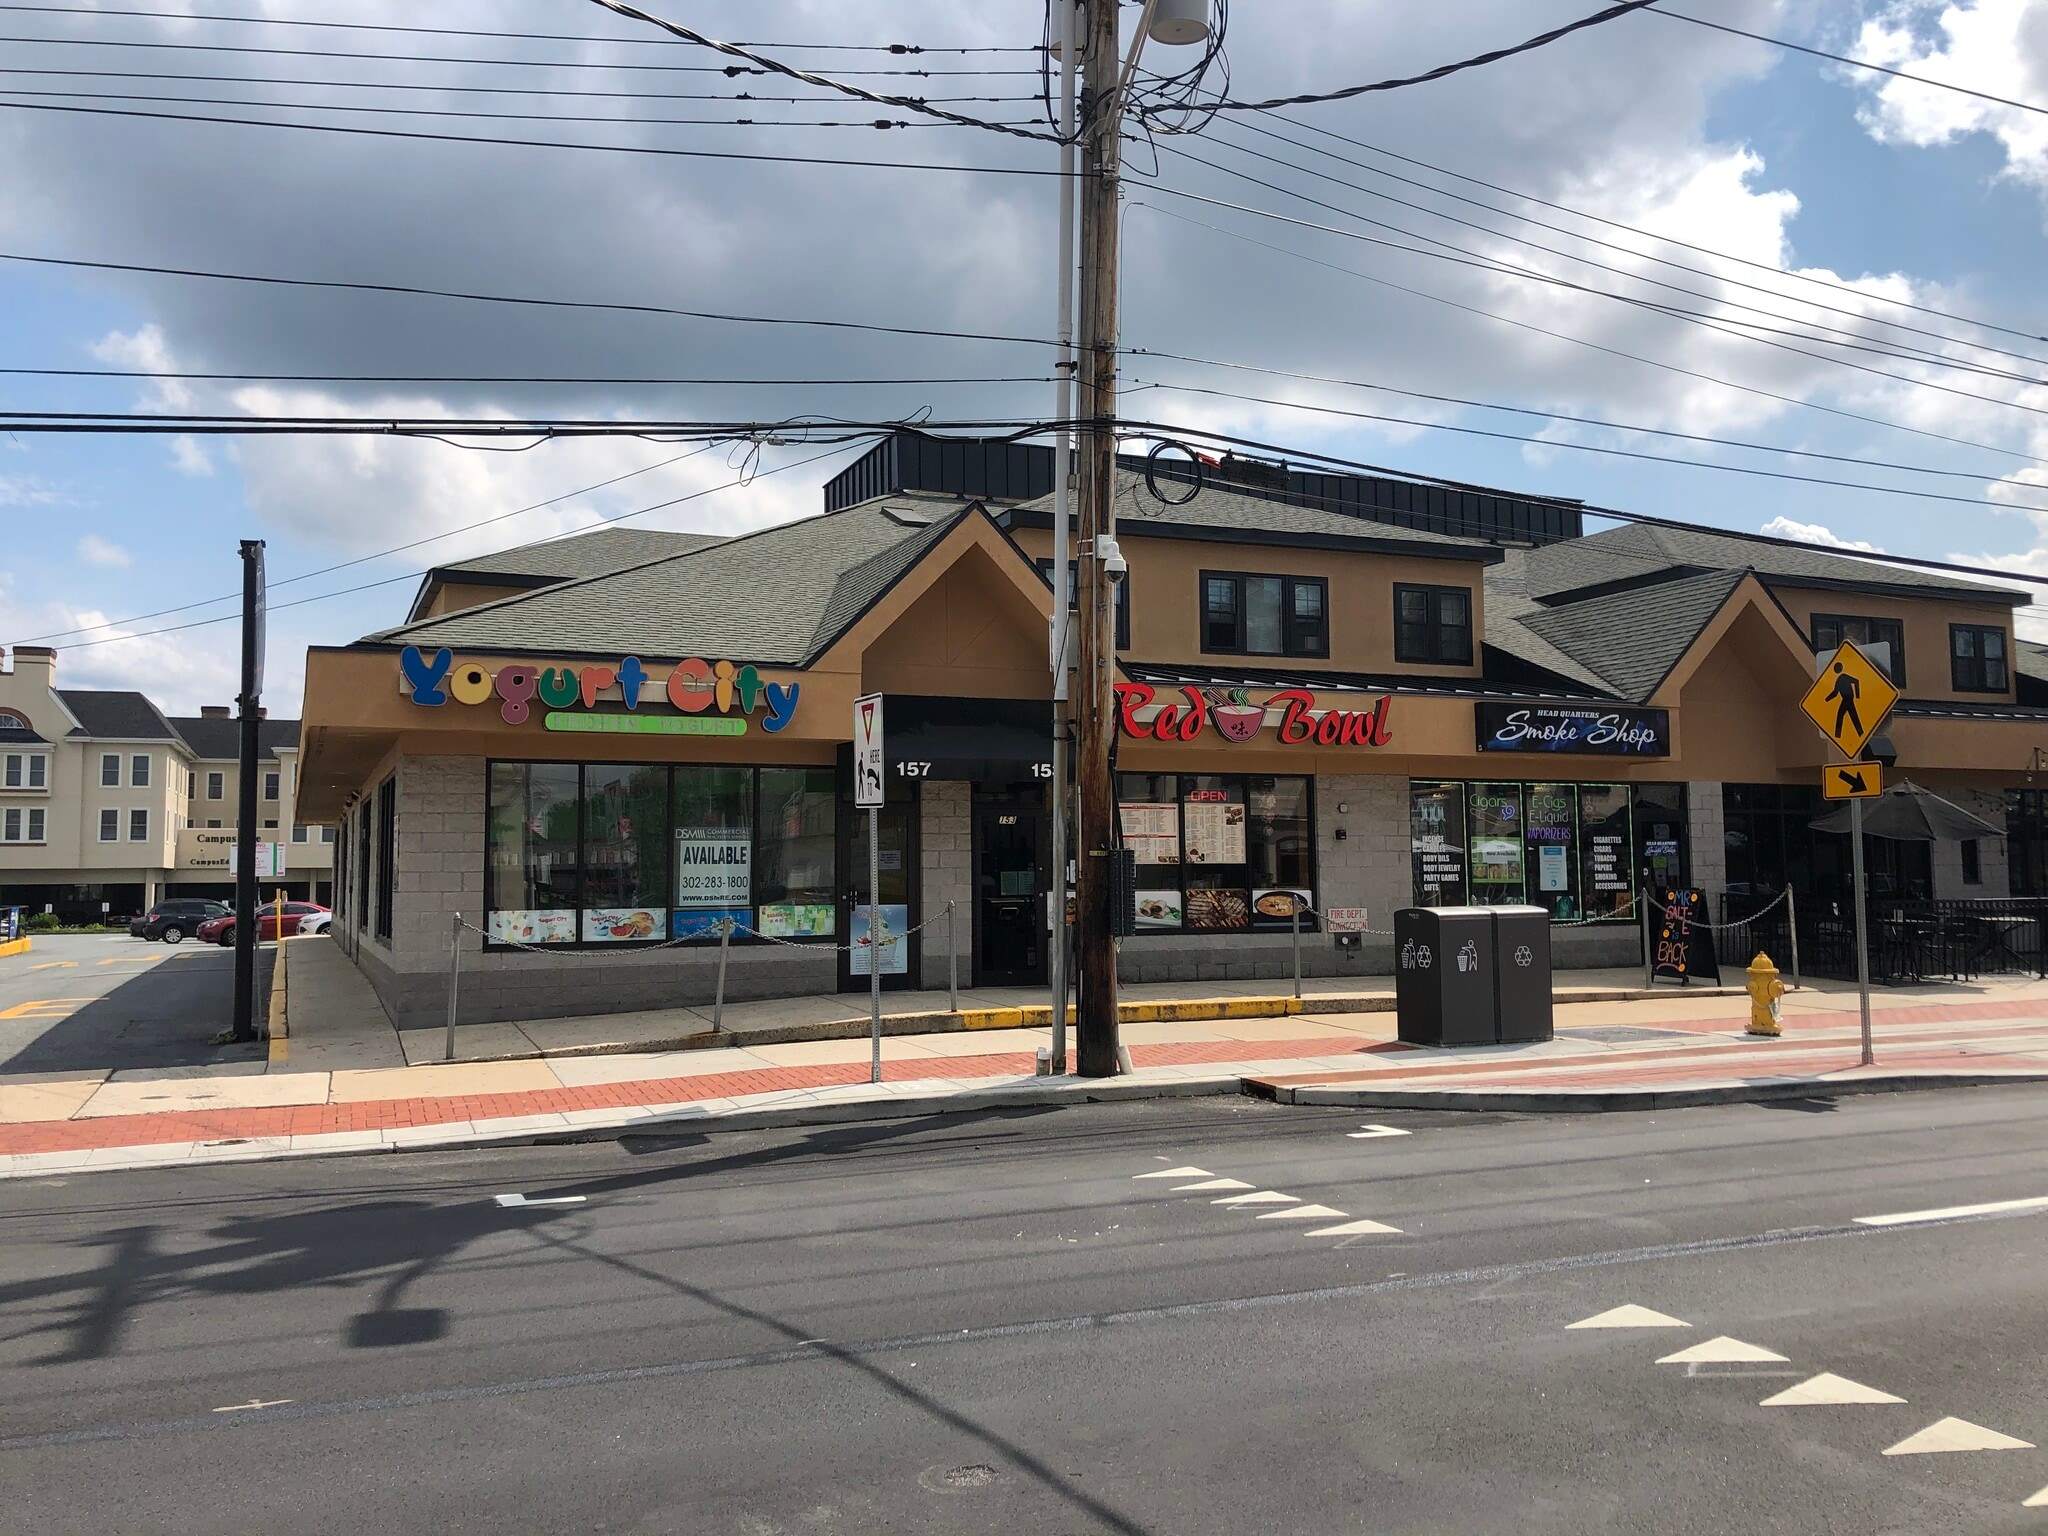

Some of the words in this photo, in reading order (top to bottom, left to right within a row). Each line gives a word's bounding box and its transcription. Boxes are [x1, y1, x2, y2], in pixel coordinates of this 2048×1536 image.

[402, 645, 649, 725] Yogurt
[668, 657, 800, 733] City
[1113, 683, 1205, 742] Red
[1264, 690, 1393, 747] Bowl
[1537, 709, 1559, 717] HEAD
[1560, 709, 1600, 719] QUARTERS
[553, 715, 639, 730] FROZEN
[659, 718, 740, 733] YOGURT
[1496, 710, 1579, 741] Smoke
[1586, 714, 1658, 751] Shop
[870, 748, 880, 764] HERE
[897, 762, 931, 777] 157
[1031, 763, 1056, 778] 15
[1191, 790, 1227, 801] OPEN
[1470, 793, 1508, 811] Cigars
[1532, 795, 1567, 811] E-Cigs
[1000, 816, 1016, 824] 153
[1529, 810, 1569, 826] E-Liquid
[197, 834, 237, 844] Campus
[1527, 827, 1571, 840] VAPORIZERS
[1593, 836, 1622, 844] CIGARETTES
[683, 846, 747, 865] AVAILABLE
[1422, 854, 1437, 862] BODY
[1438, 854, 1450, 862] OILS
[1423, 864, 1438, 872] BODY
[1438, 864, 1461, 872] JEWELRY
[1594, 864, 1613, 872] PAPERS
[682, 876, 748, 888] 302-283-1800
[1595, 873, 1618, 881] SMOKING
[1595, 882, 1628, 890] ACCESSORIES
[1330, 910, 1345, 918] FIRE
[1346, 910, 1365, 918] DEPT.
[1658, 941, 1689, 963] BACK
